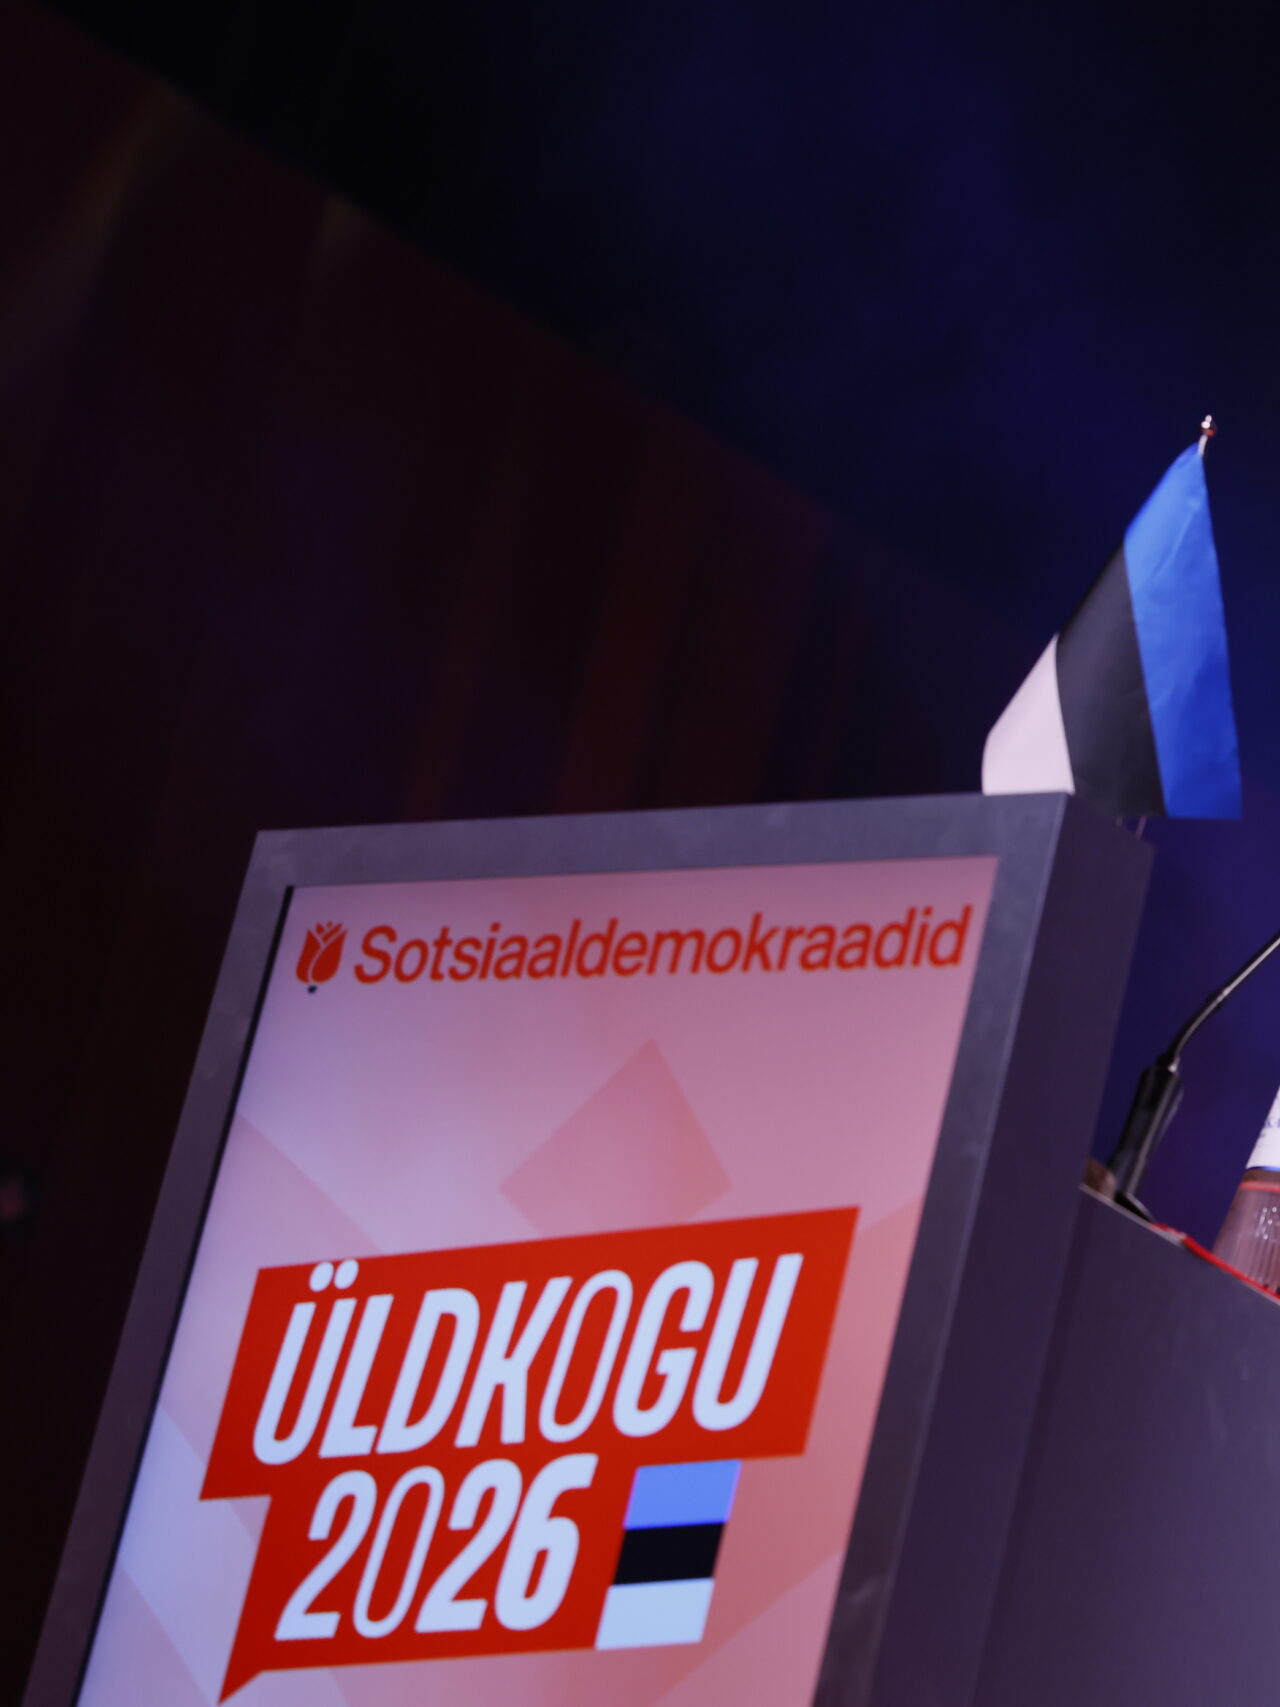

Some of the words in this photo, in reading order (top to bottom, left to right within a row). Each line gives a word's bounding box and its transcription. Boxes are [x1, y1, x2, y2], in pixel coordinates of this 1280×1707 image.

[354, 905, 973, 984] Sotsiaaldemokraadid
[253, 1253, 803, 1465] ÜLDKOGU
[274, 1453, 599, 1640] 2026
